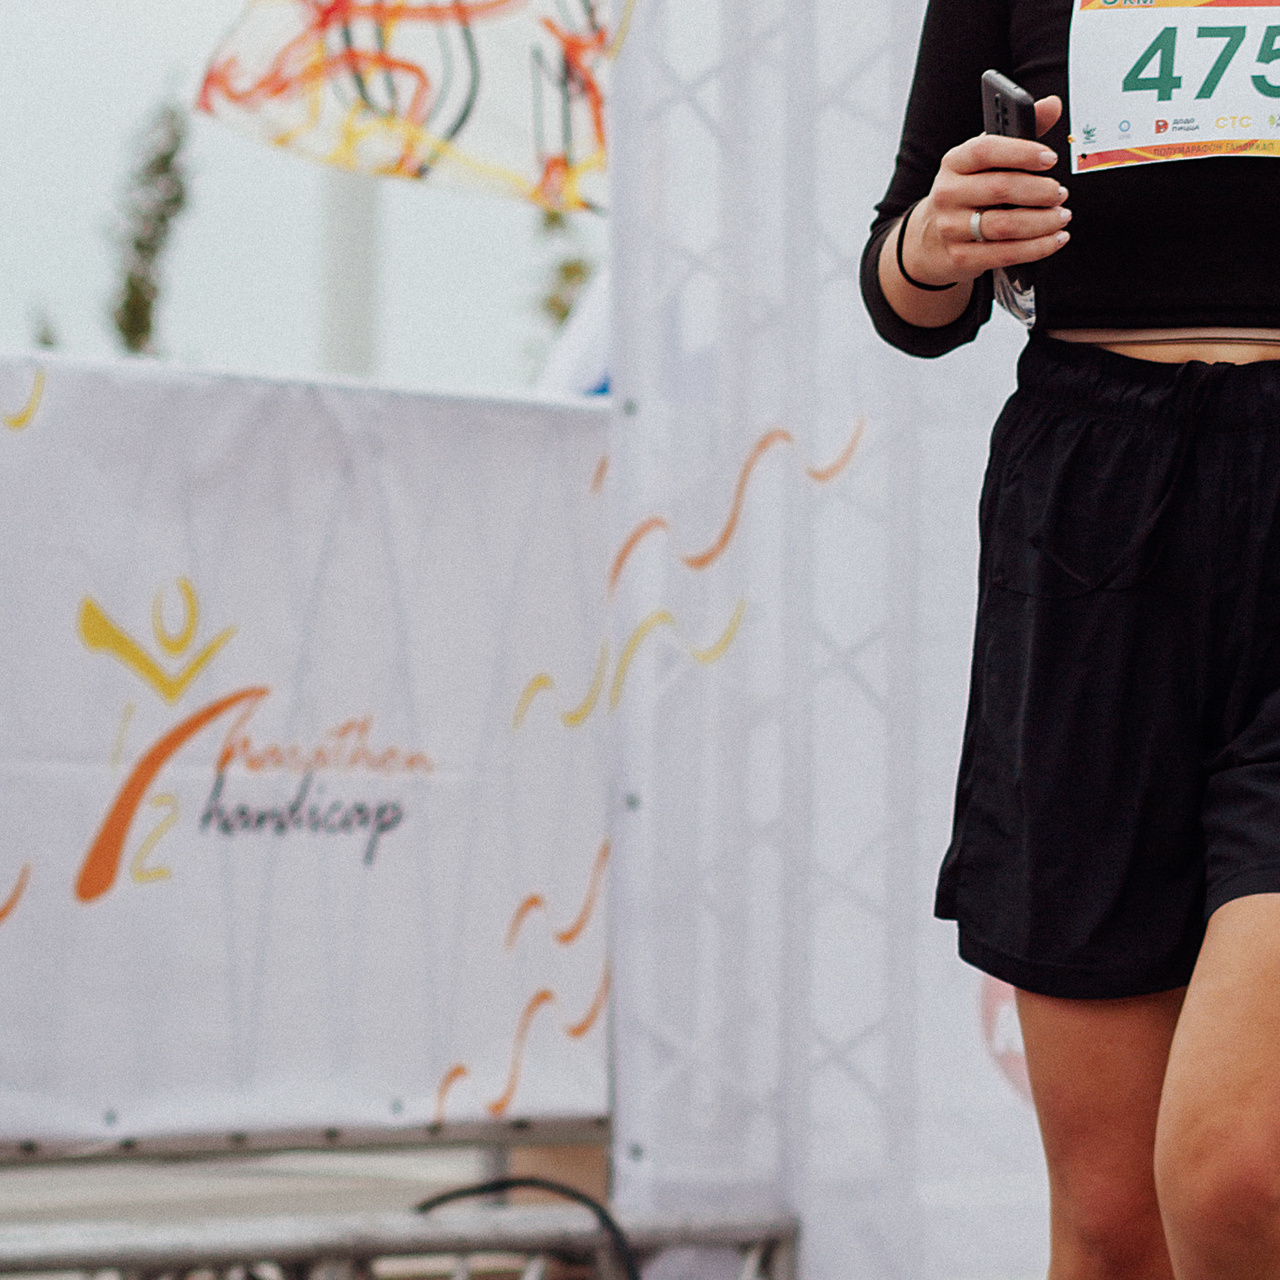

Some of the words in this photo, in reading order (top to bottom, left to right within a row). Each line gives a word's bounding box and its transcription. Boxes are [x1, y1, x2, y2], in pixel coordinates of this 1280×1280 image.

[1215, 115, 1252, 129] СТС
[1153, 143, 1223, 157] ПОЛУМАРАФОН
[1225, 142, 1274, 152] ГАНДИКАП
[200, 770, 404, 866] handicap
